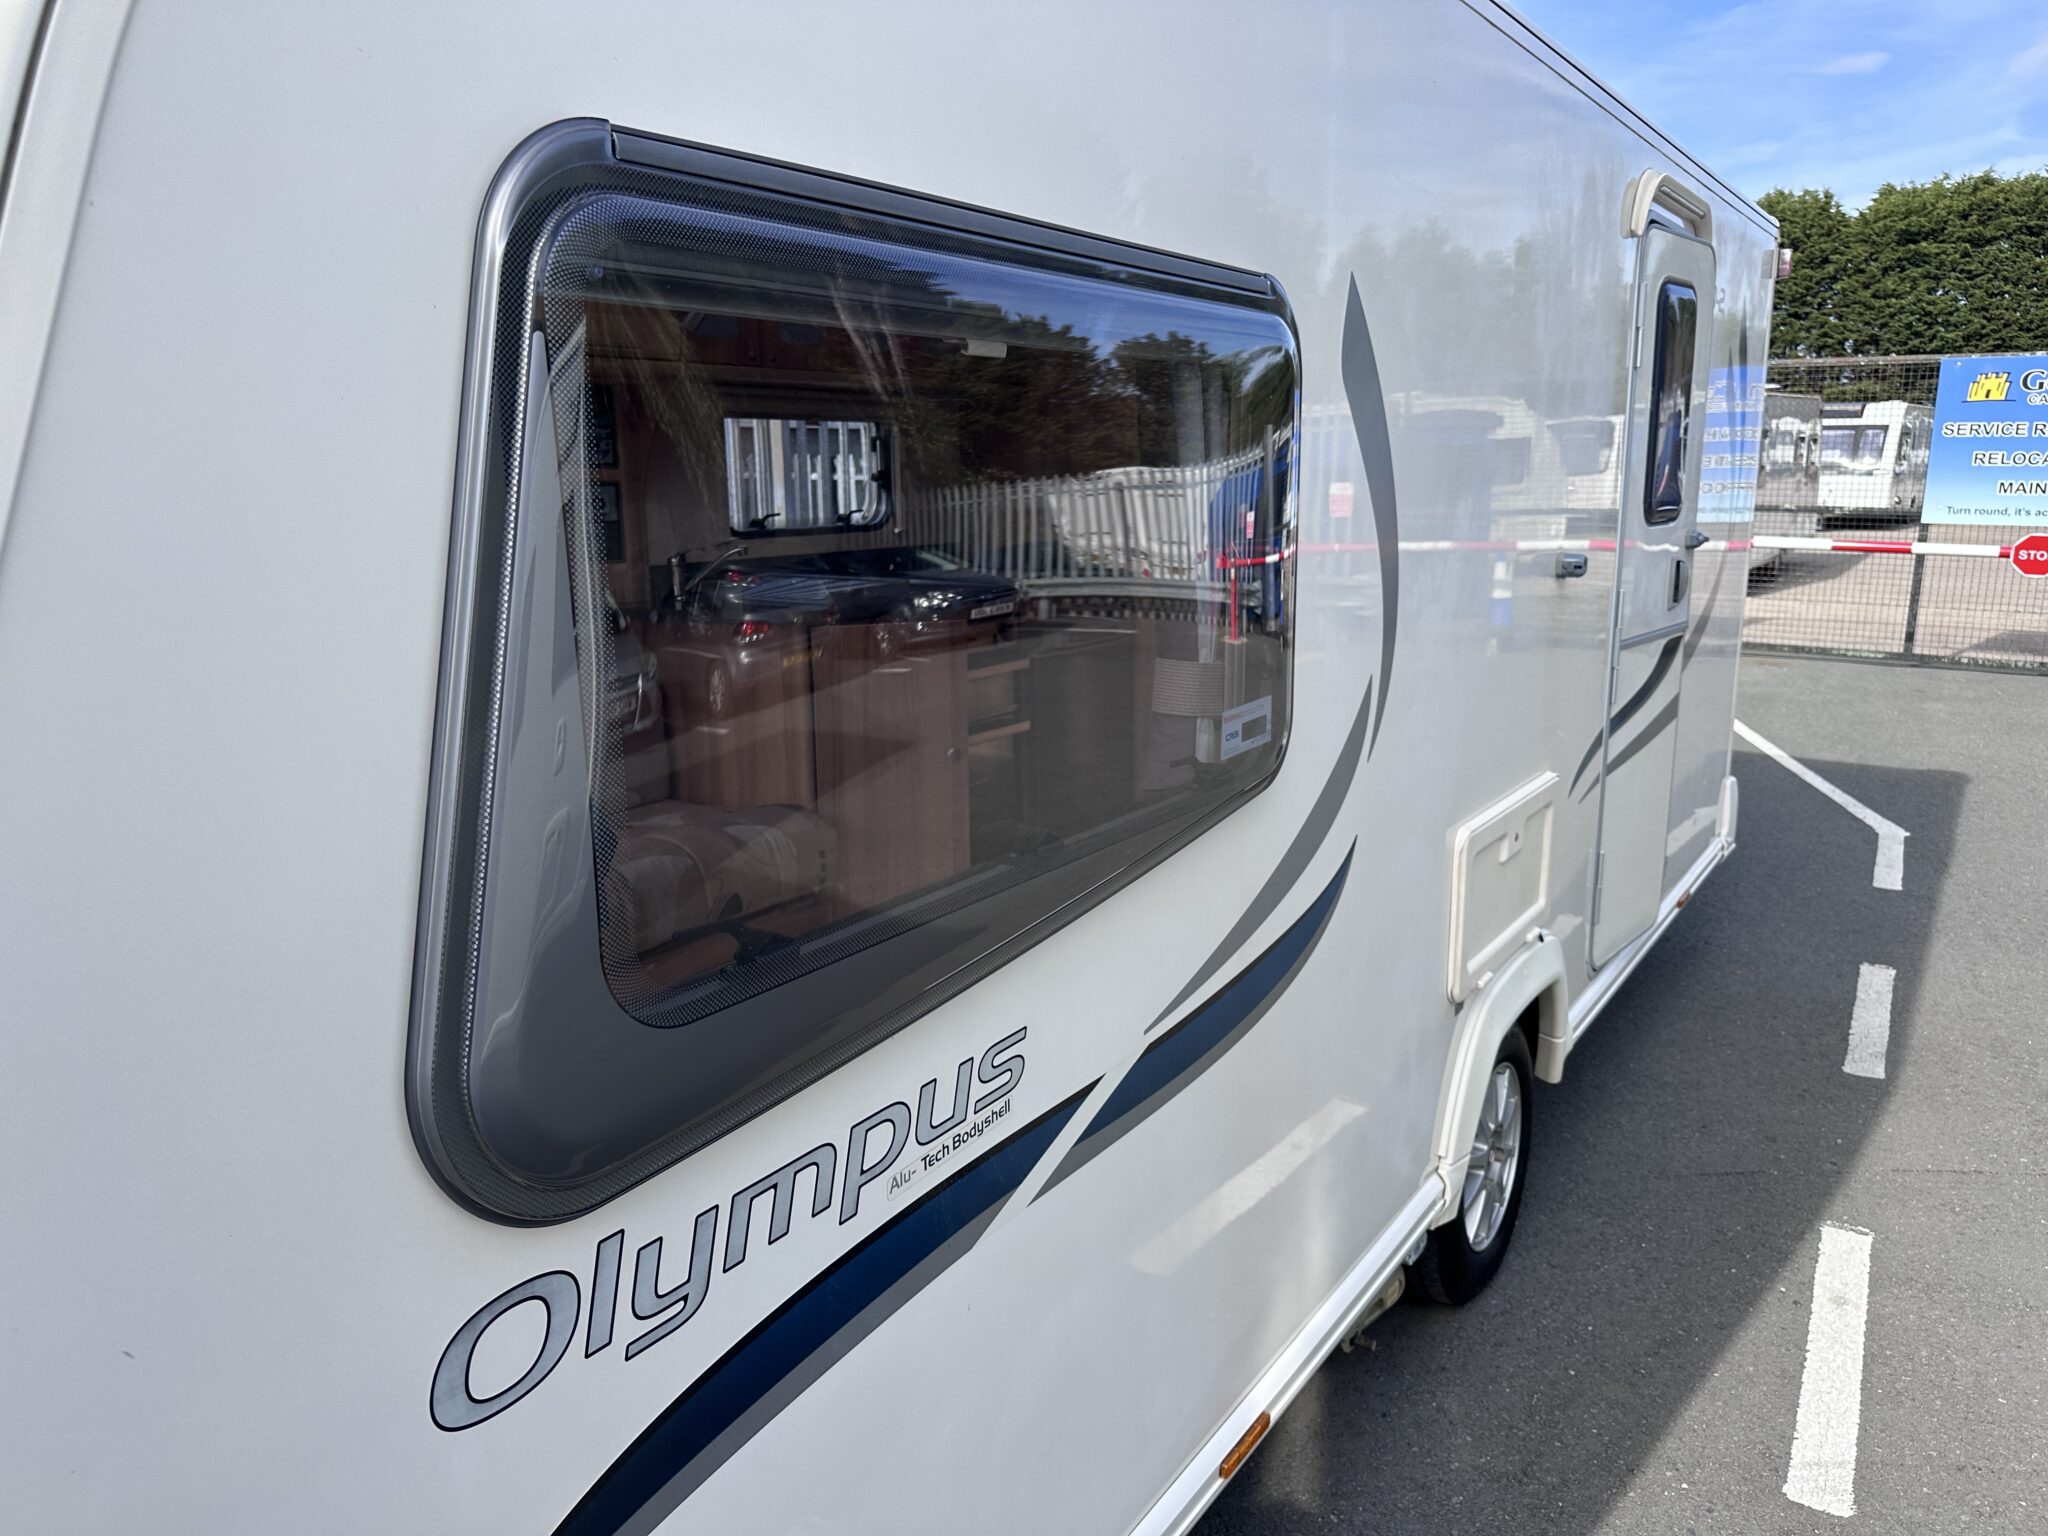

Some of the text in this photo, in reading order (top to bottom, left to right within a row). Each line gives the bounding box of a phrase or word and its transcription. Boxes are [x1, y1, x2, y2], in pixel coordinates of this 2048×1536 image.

[2021, 370, 2048, 391] G
[2028, 394, 2048, 404] CA
[1943, 423, 2048, 436] SERVICE R
[1974, 452, 2048, 465] RELOCA
[1998, 481, 2048, 495] MAIN
[1947, 506, 2048, 518] Turn round, it's ac
[2018, 549, 2048, 562] STO
[889, 1098, 1011, 1195] Alu- Tech Bodyshell
[429, 1026, 1029, 1433] Olympus
